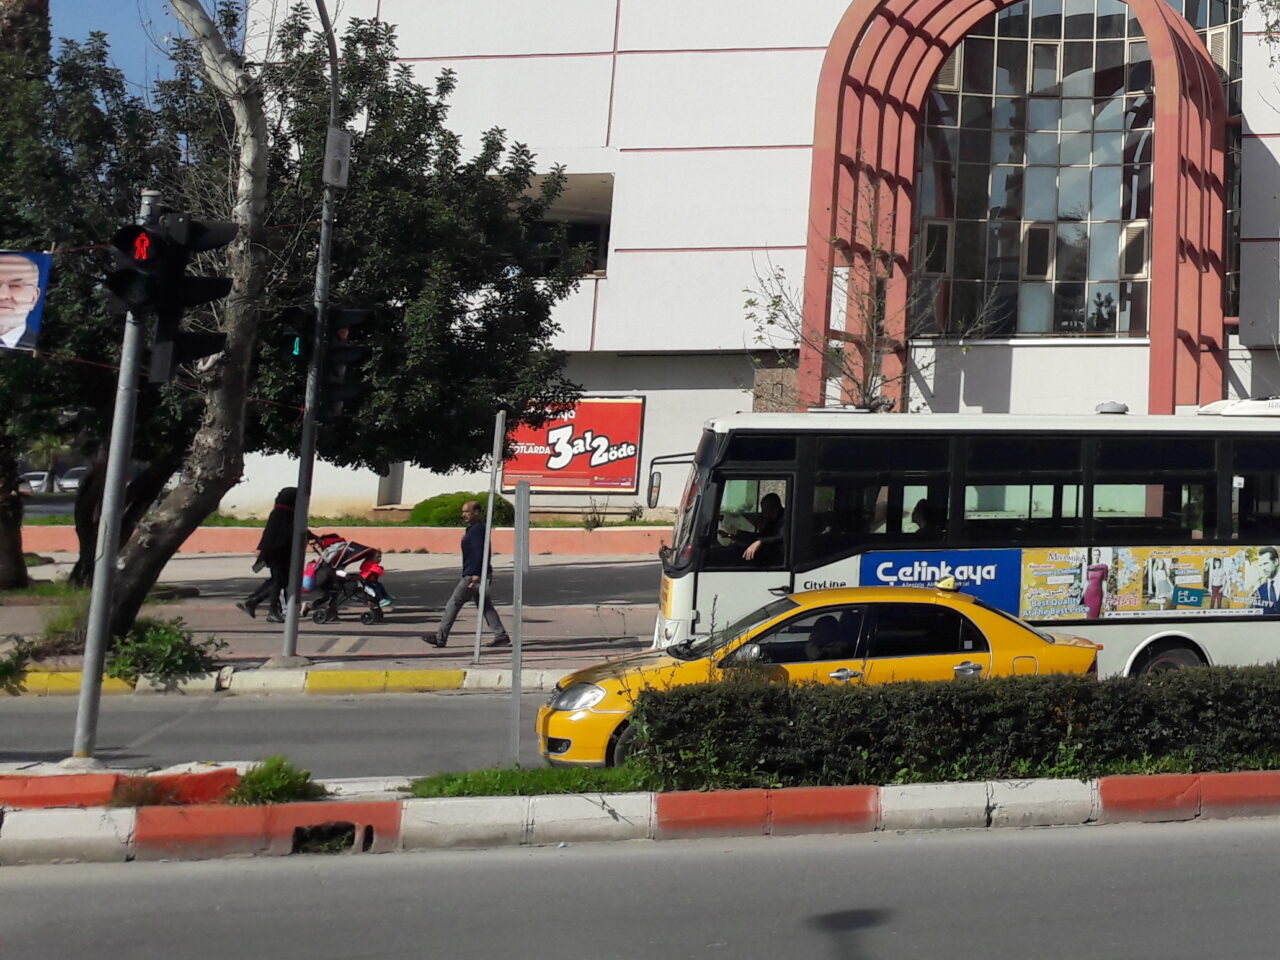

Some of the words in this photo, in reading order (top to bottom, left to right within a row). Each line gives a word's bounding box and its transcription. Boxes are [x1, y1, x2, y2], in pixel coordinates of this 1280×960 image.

[877, 561, 996, 586] Çetinkaya
[804, 580, 846, 589] CityLine
[1051, 597, 1080, 605] Quality
